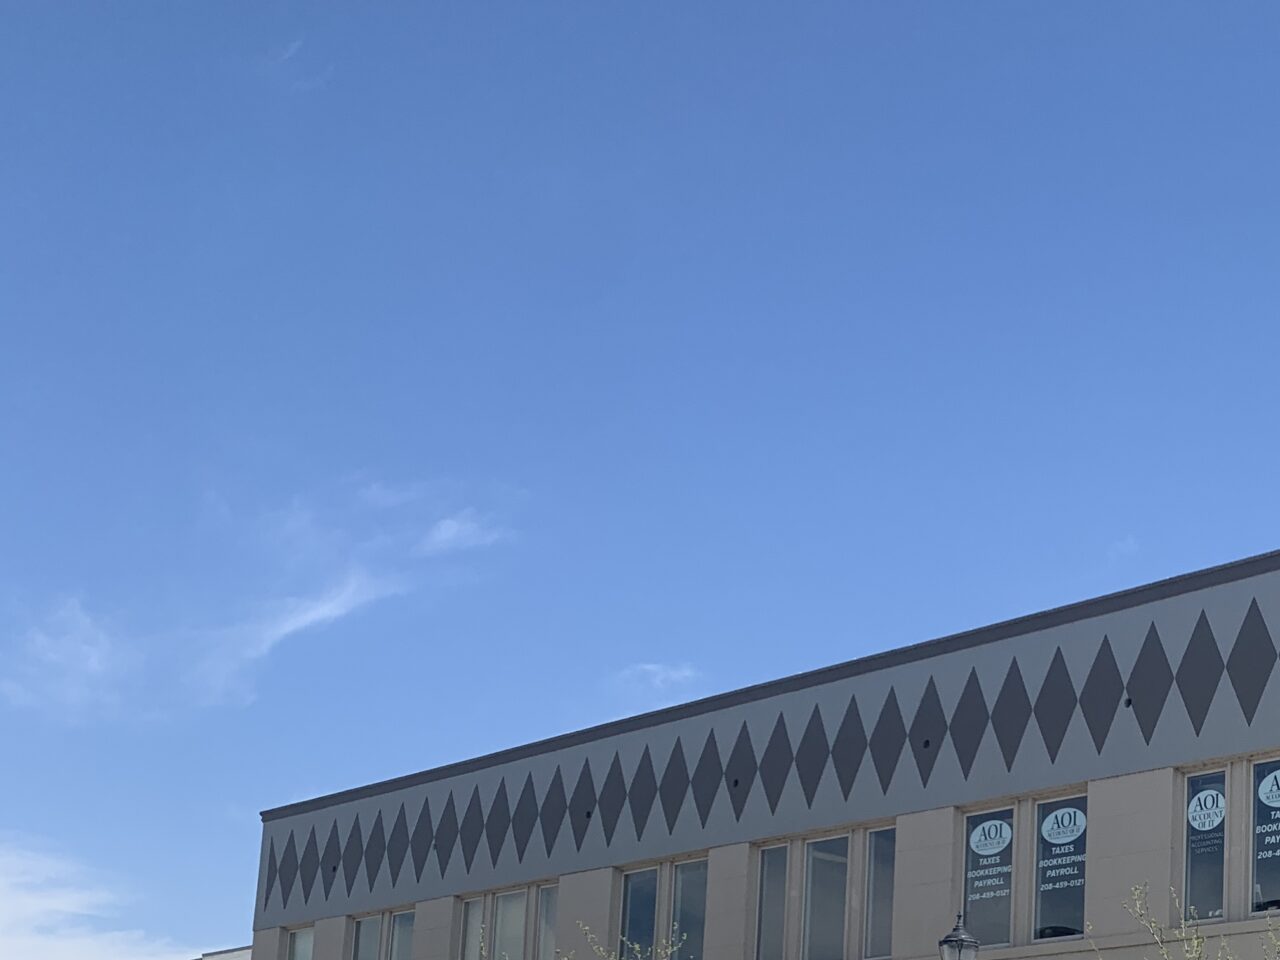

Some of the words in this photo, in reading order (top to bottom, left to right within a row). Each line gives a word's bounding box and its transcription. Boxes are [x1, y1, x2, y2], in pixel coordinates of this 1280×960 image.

[1193, 793, 1220, 812] AOI
[1050, 810, 1078, 830] AOI
[1190, 809, 1224, 822] ACCOUNT
[1208, 819, 1216, 828] IT
[978, 823, 1007, 842] AOI
[1051, 844, 1075, 855] TAXES
[979, 855, 1001, 866] TAXES
[1038, 854, 1087, 868] BOOKKEEPING
[966, 865, 1012, 879] BOOKKEEPING
[1046, 866, 1080, 878] PAYROLL
[973, 877, 1005, 888] PAYROLL
[1039, 878, 1085, 892] 208-459-0121
